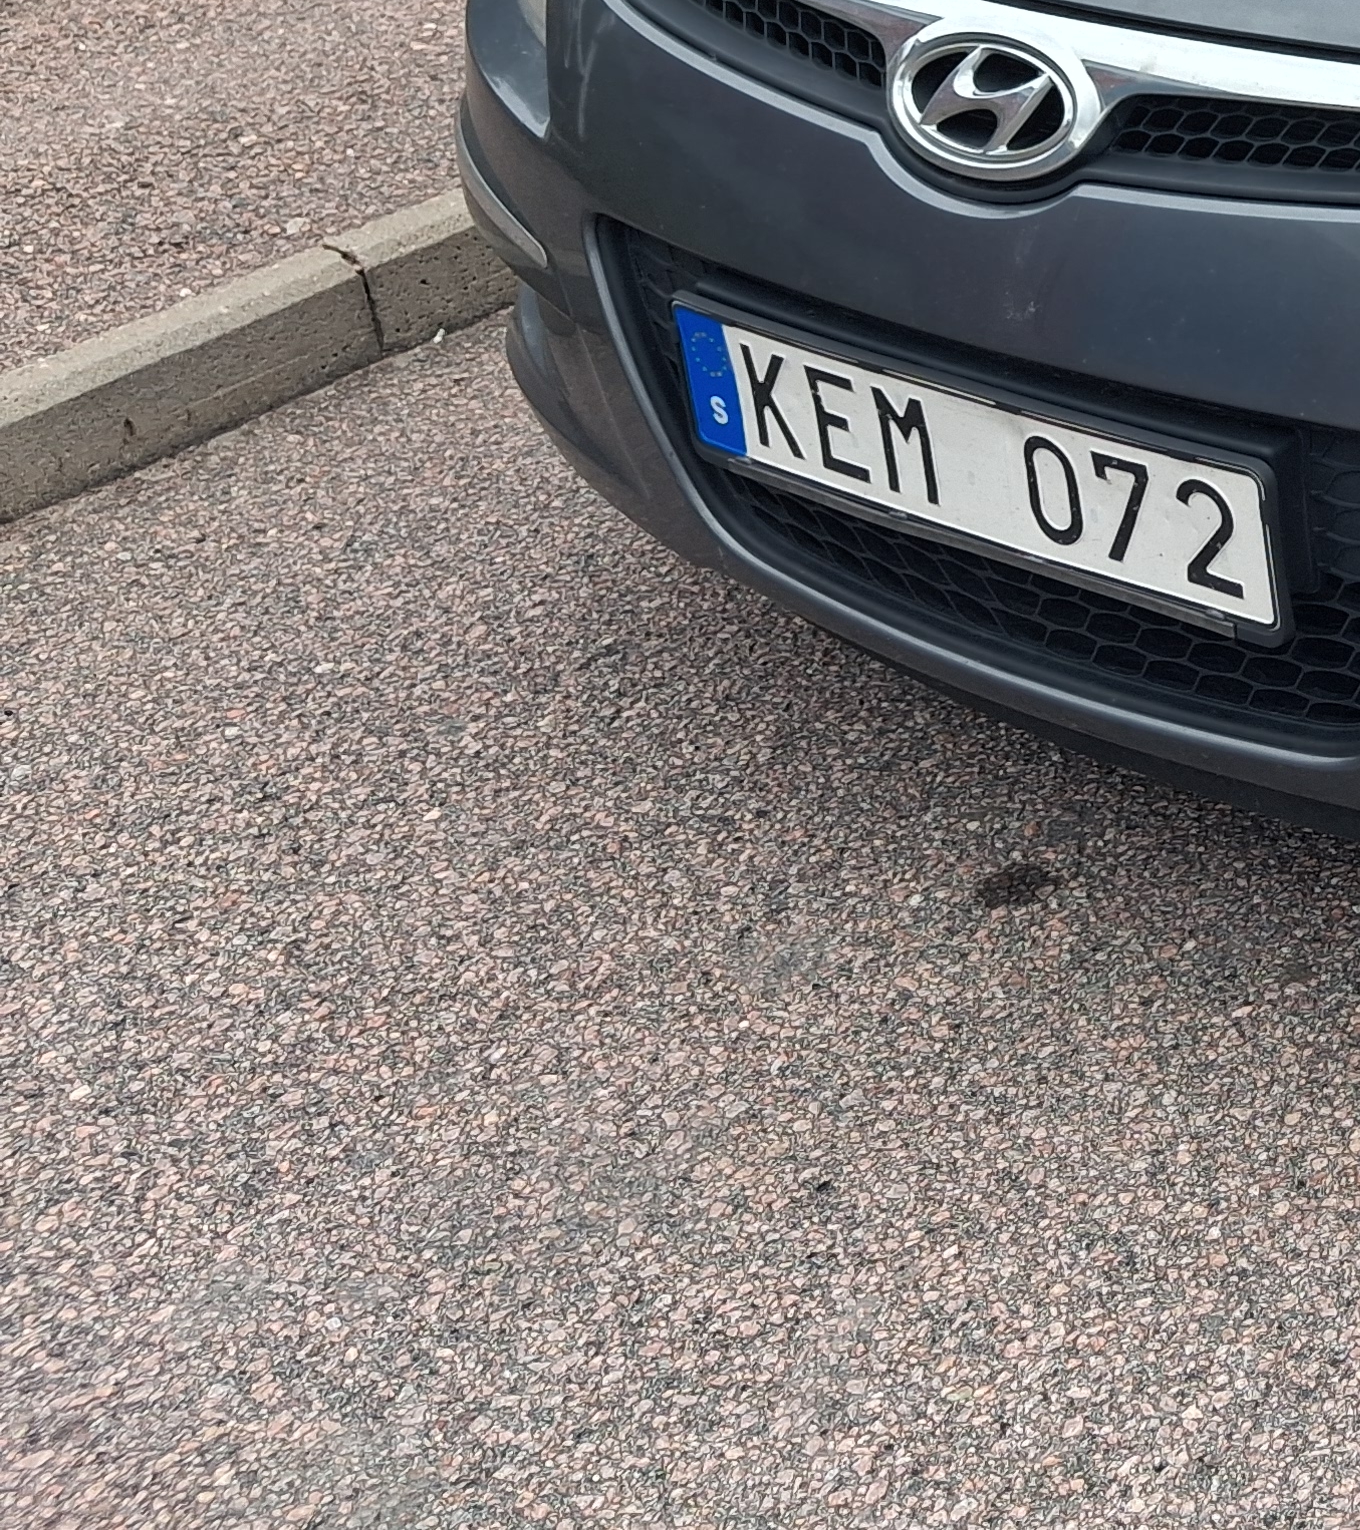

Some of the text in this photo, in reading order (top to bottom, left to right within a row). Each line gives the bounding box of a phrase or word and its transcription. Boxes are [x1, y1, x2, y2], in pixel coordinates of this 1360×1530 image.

[711, 395, 729, 425] S
[739, 342, 1245, 600] KEM 072
